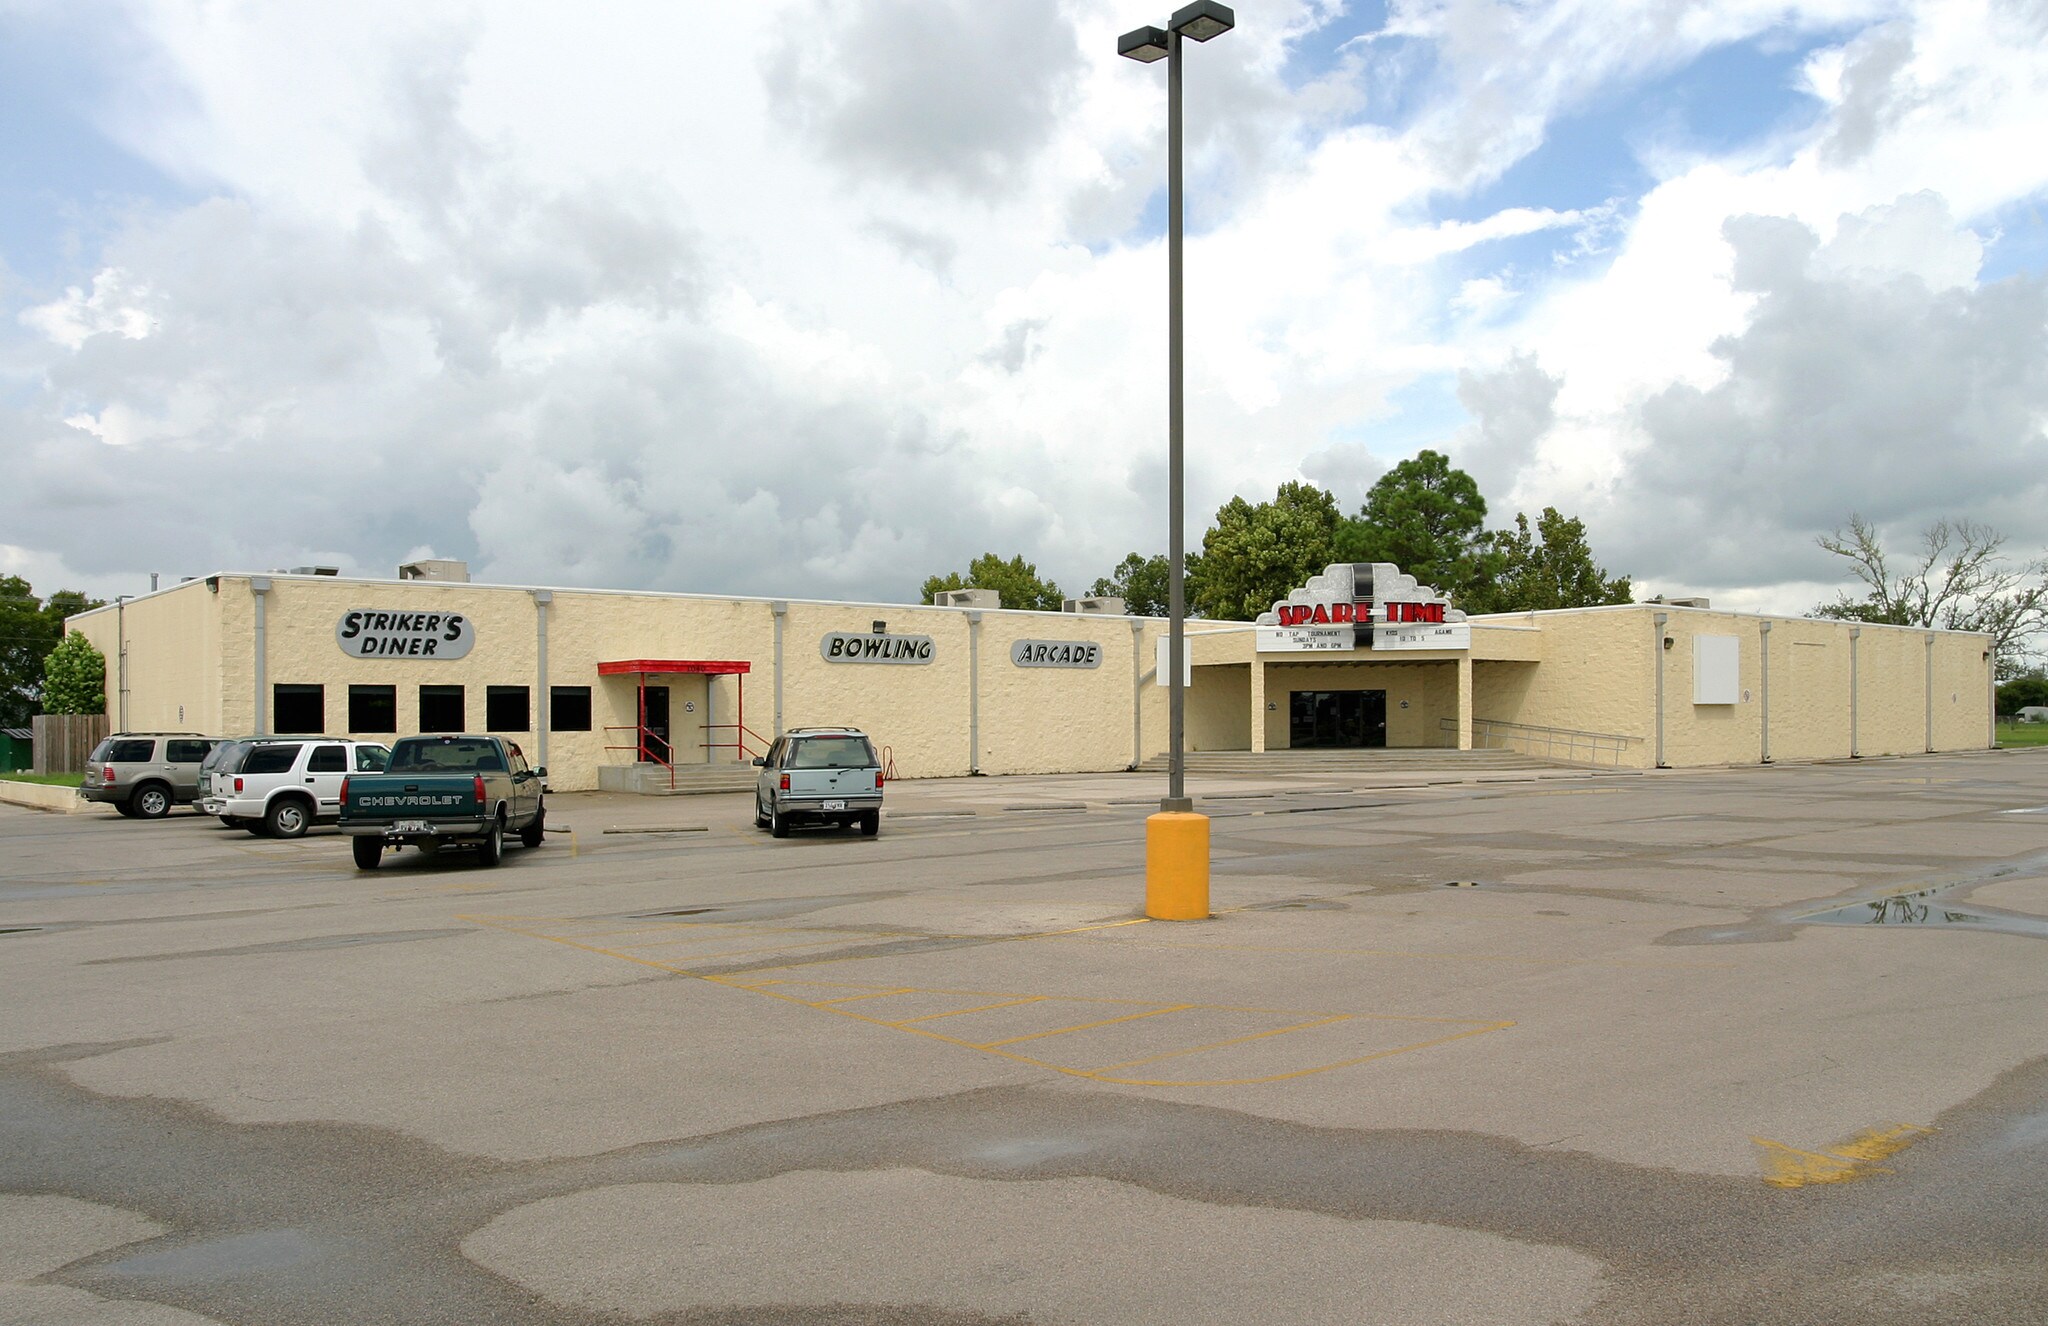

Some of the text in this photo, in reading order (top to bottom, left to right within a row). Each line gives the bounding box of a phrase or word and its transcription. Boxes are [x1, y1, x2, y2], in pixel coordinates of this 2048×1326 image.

[1278, 602, 1446, 626] SPARE TIME
[341, 612, 463, 641] STRIKER'S
[360, 637, 438, 655] DINER
[828, 638, 931, 659] BOWLING
[1017, 644, 1097, 664] ARCADE
[359, 795, 463, 806] CHEVROLET
